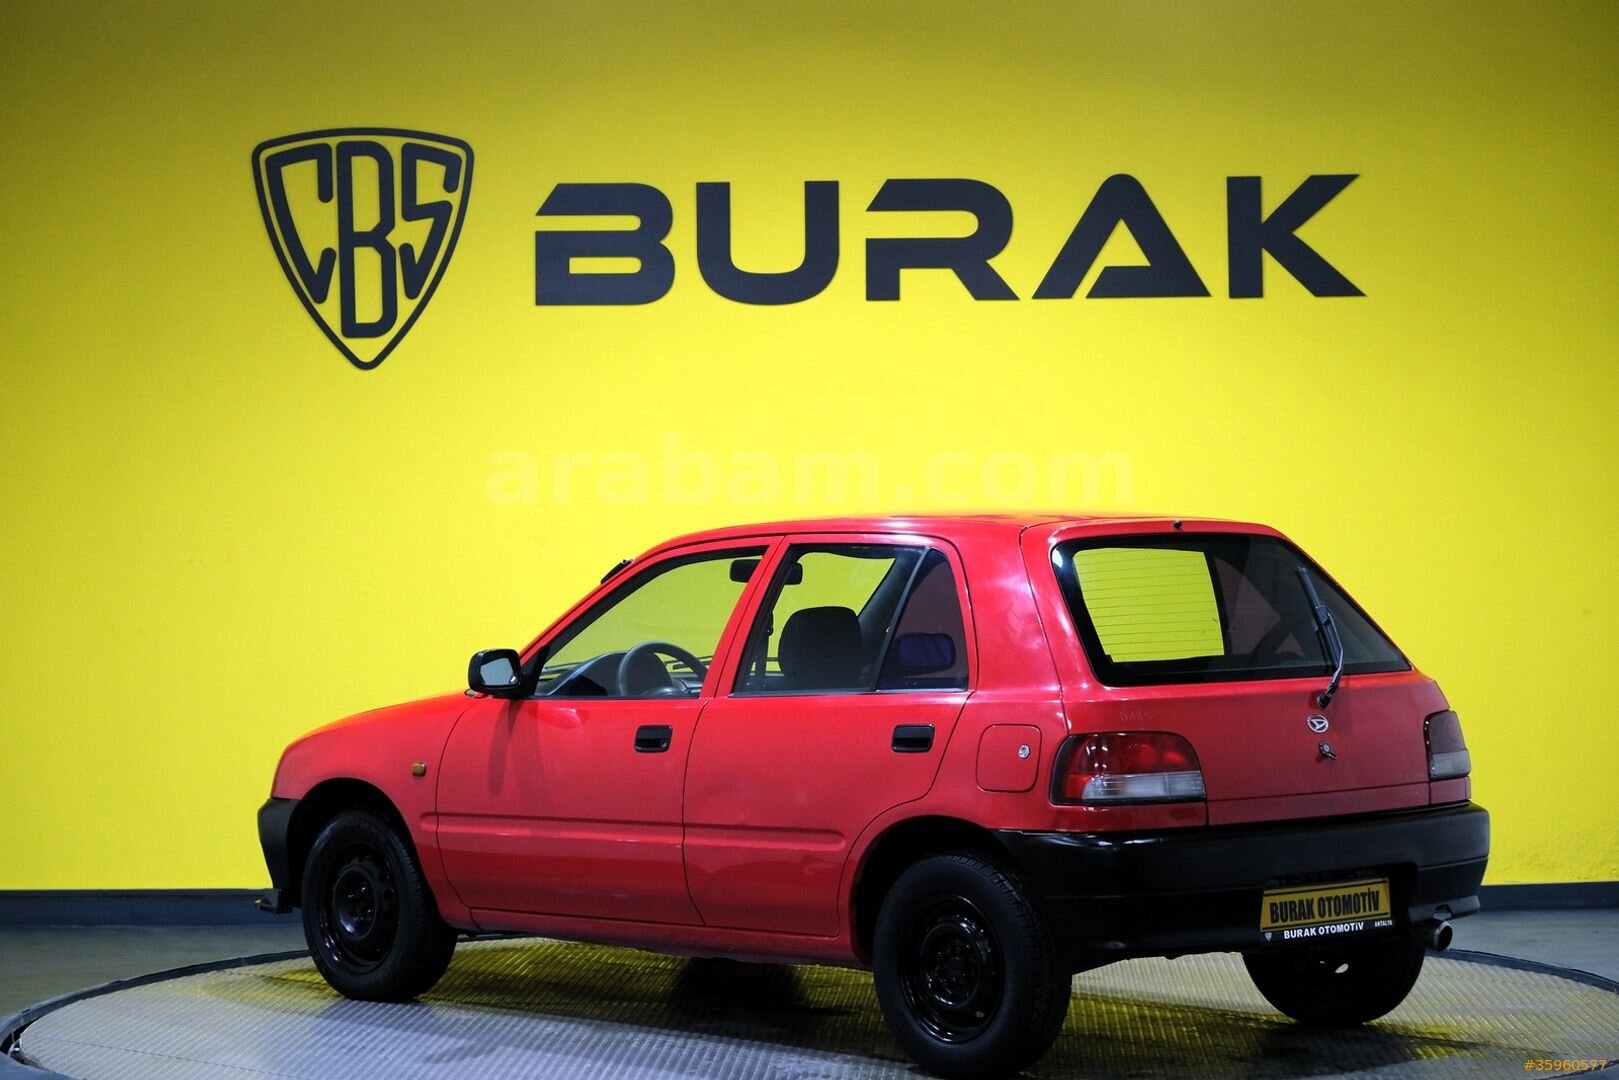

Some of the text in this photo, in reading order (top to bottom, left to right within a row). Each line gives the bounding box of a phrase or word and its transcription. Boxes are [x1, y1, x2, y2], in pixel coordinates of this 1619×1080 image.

[265, 141, 462, 338] CBS
[535, 173, 1367, 306] BURAK
[1270, 899, 1315, 923] BURAK
[1284, 928, 1317, 939] BURAK
